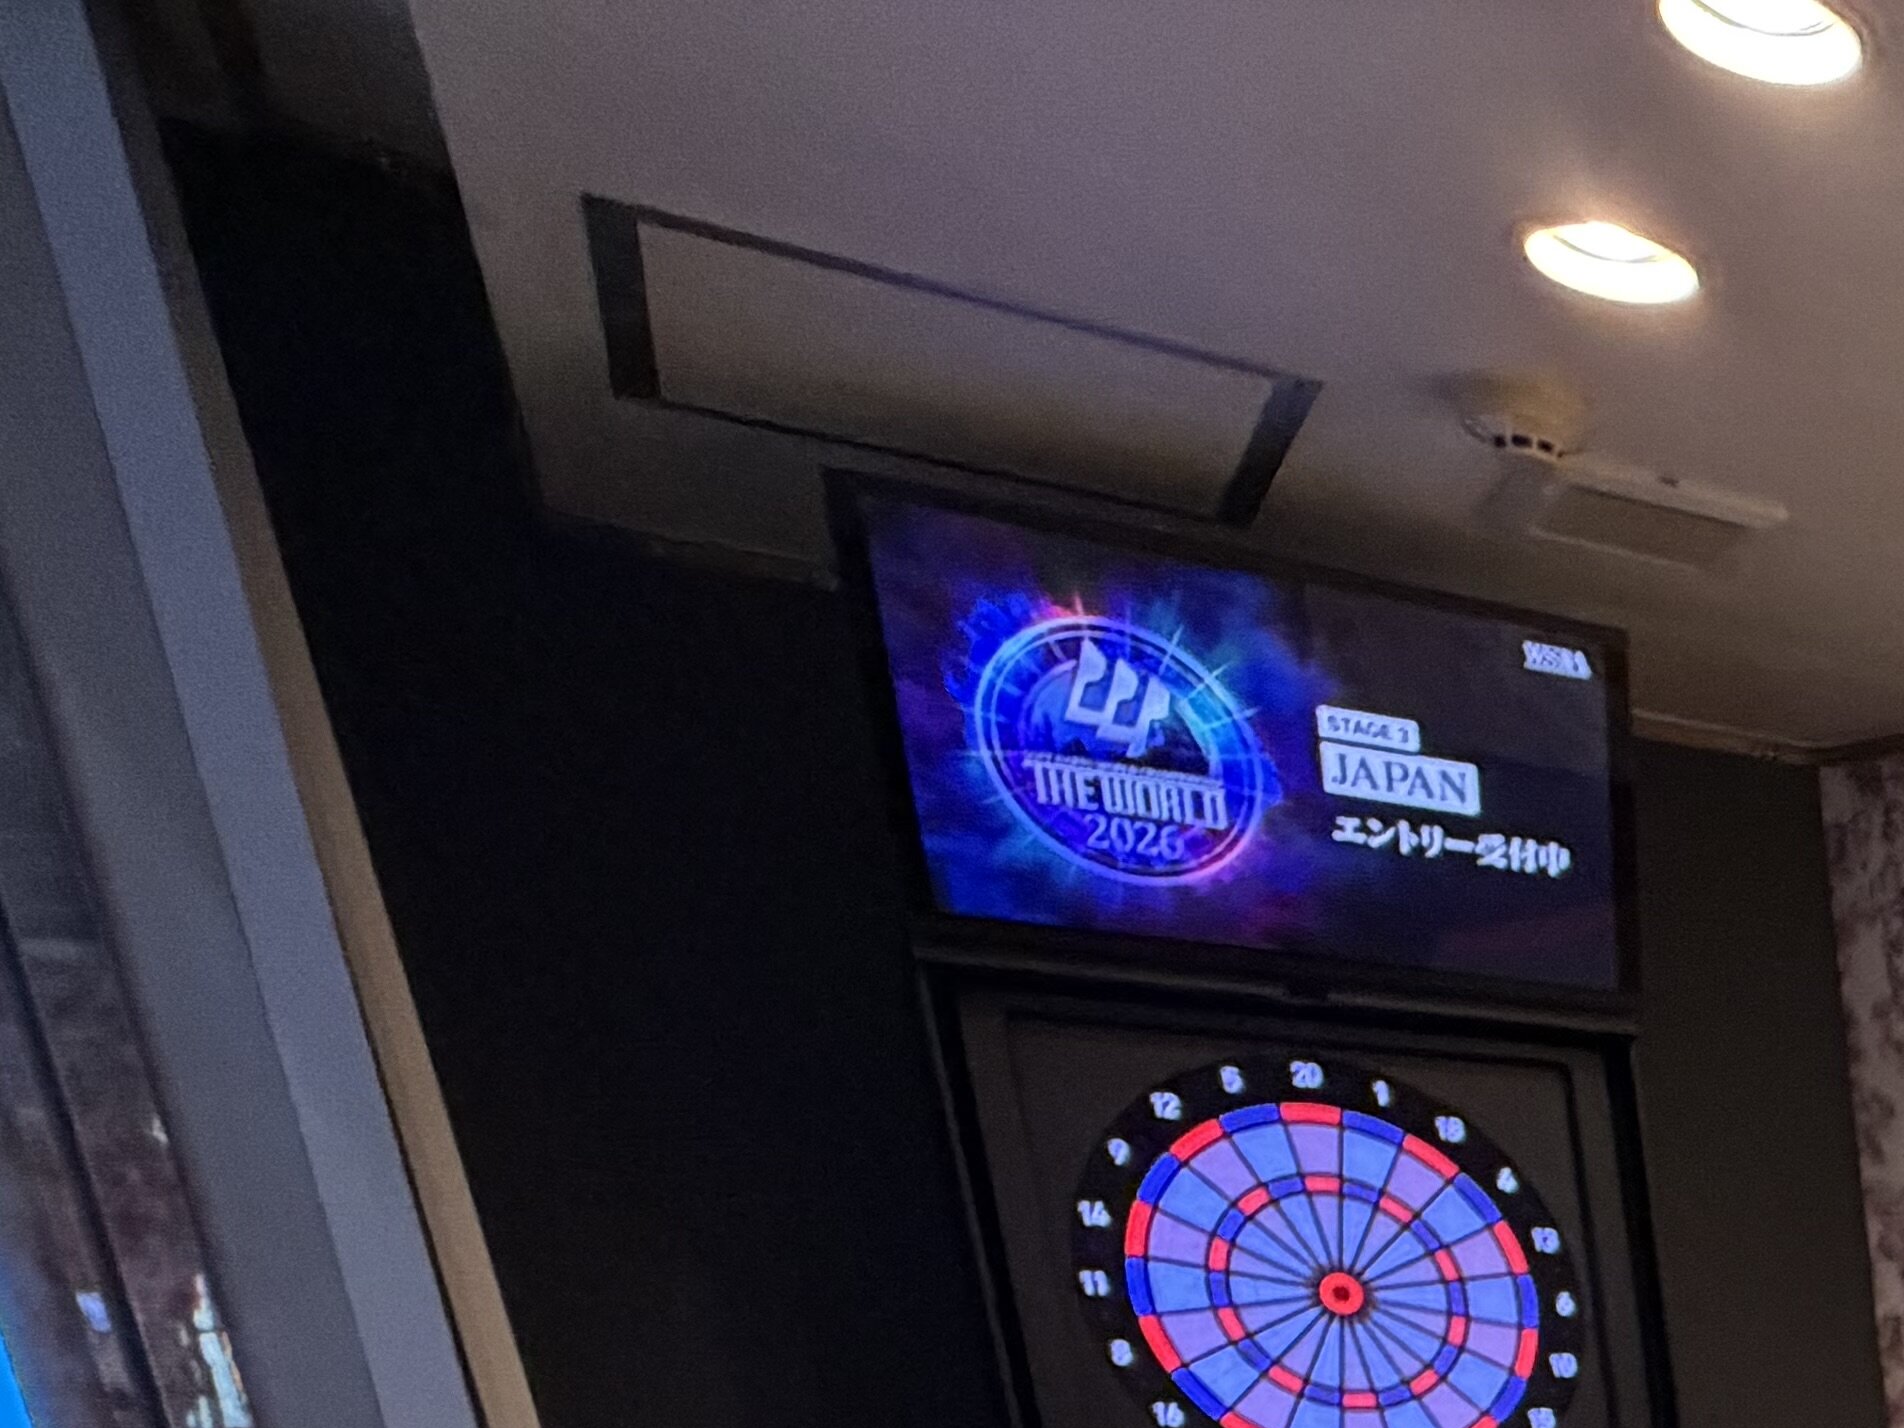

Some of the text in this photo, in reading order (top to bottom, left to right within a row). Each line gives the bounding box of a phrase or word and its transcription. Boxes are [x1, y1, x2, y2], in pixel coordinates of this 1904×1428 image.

[1327, 714, 1393, 741] STAGE
[1023, 757, 1100, 812] THE
[1100, 773, 1229, 831] WORLD
[1330, 753, 1467, 804] JAPAN
[1084, 812, 1185, 860] 2026
